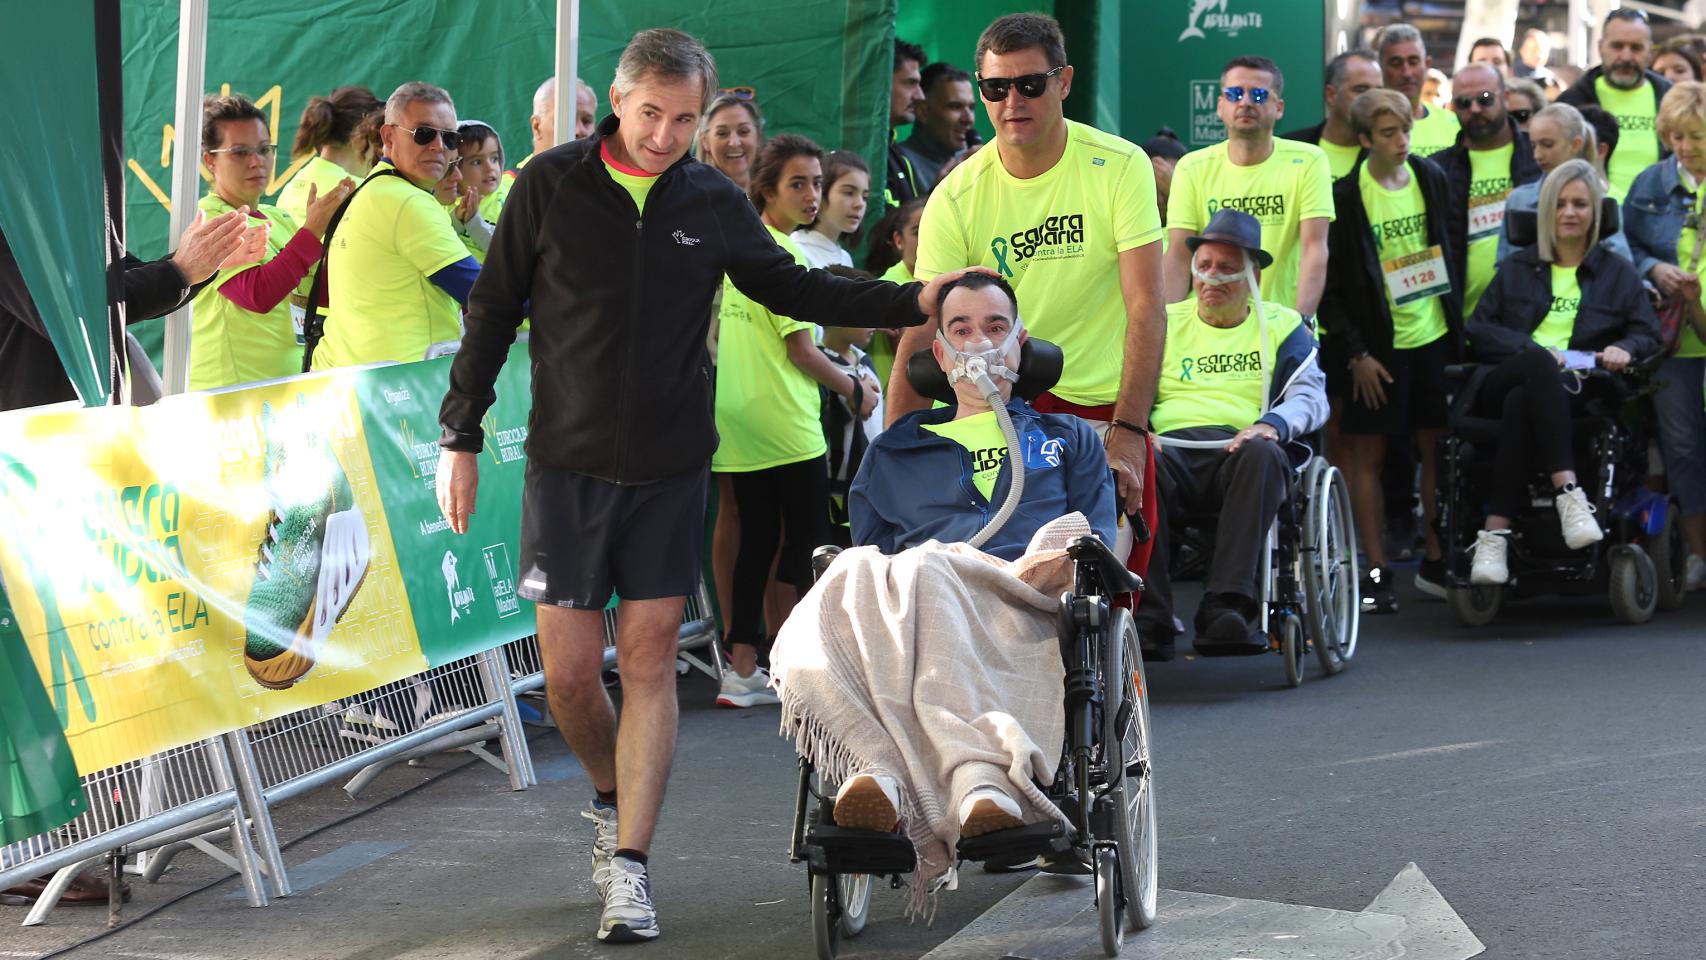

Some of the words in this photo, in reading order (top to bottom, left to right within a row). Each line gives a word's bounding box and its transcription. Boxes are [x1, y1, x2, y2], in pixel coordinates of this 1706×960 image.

[1066, 244, 1084, 254] ELA
[1403, 270, 1437, 288] 1128
[1197, 350, 1262, 367] carrera
[500, 445, 524, 463] RURAL
[167, 590, 209, 634] ELA
